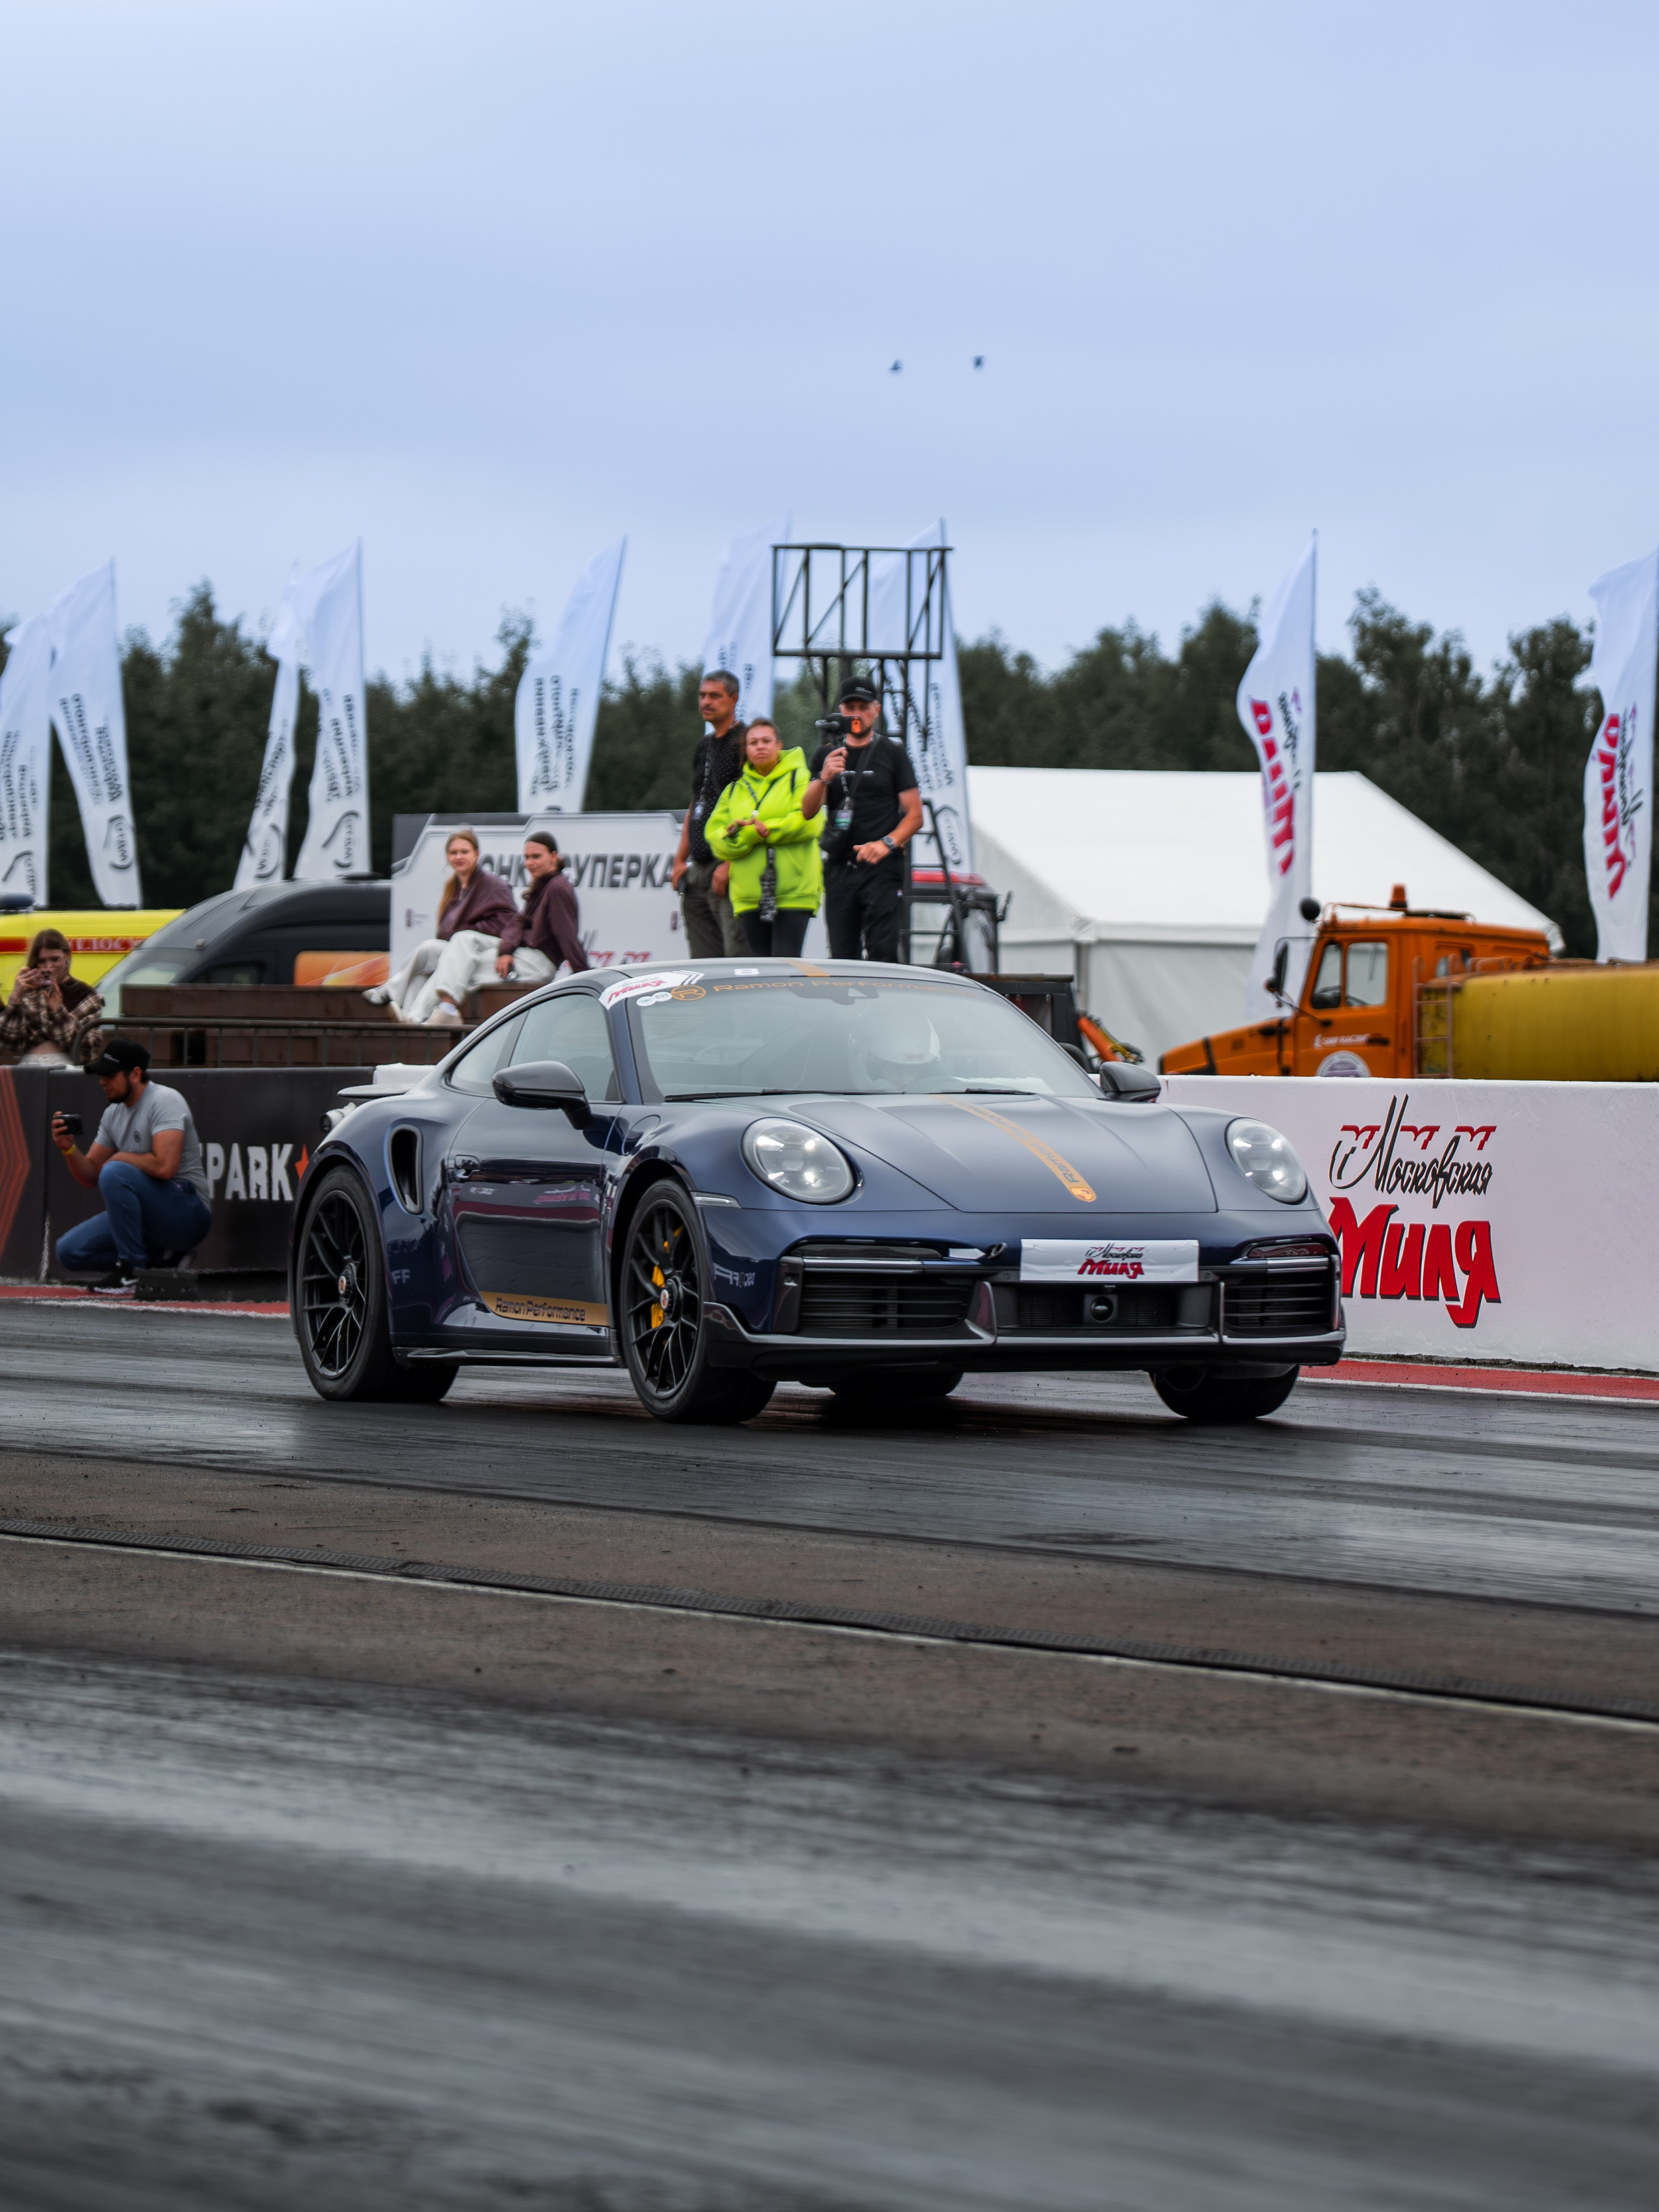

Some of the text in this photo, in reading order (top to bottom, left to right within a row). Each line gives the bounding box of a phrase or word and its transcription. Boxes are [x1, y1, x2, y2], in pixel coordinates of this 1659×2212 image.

[713, 981, 800, 992] Ramon
[199, 1142, 294, 1201] PARK
[1329, 1093, 1494, 1209] Московская
[1076, 1257, 1144, 1279] Миля
[1328, 1196, 1502, 1329] Миля
[495, 1297, 586, 1321] Ramon Performance
